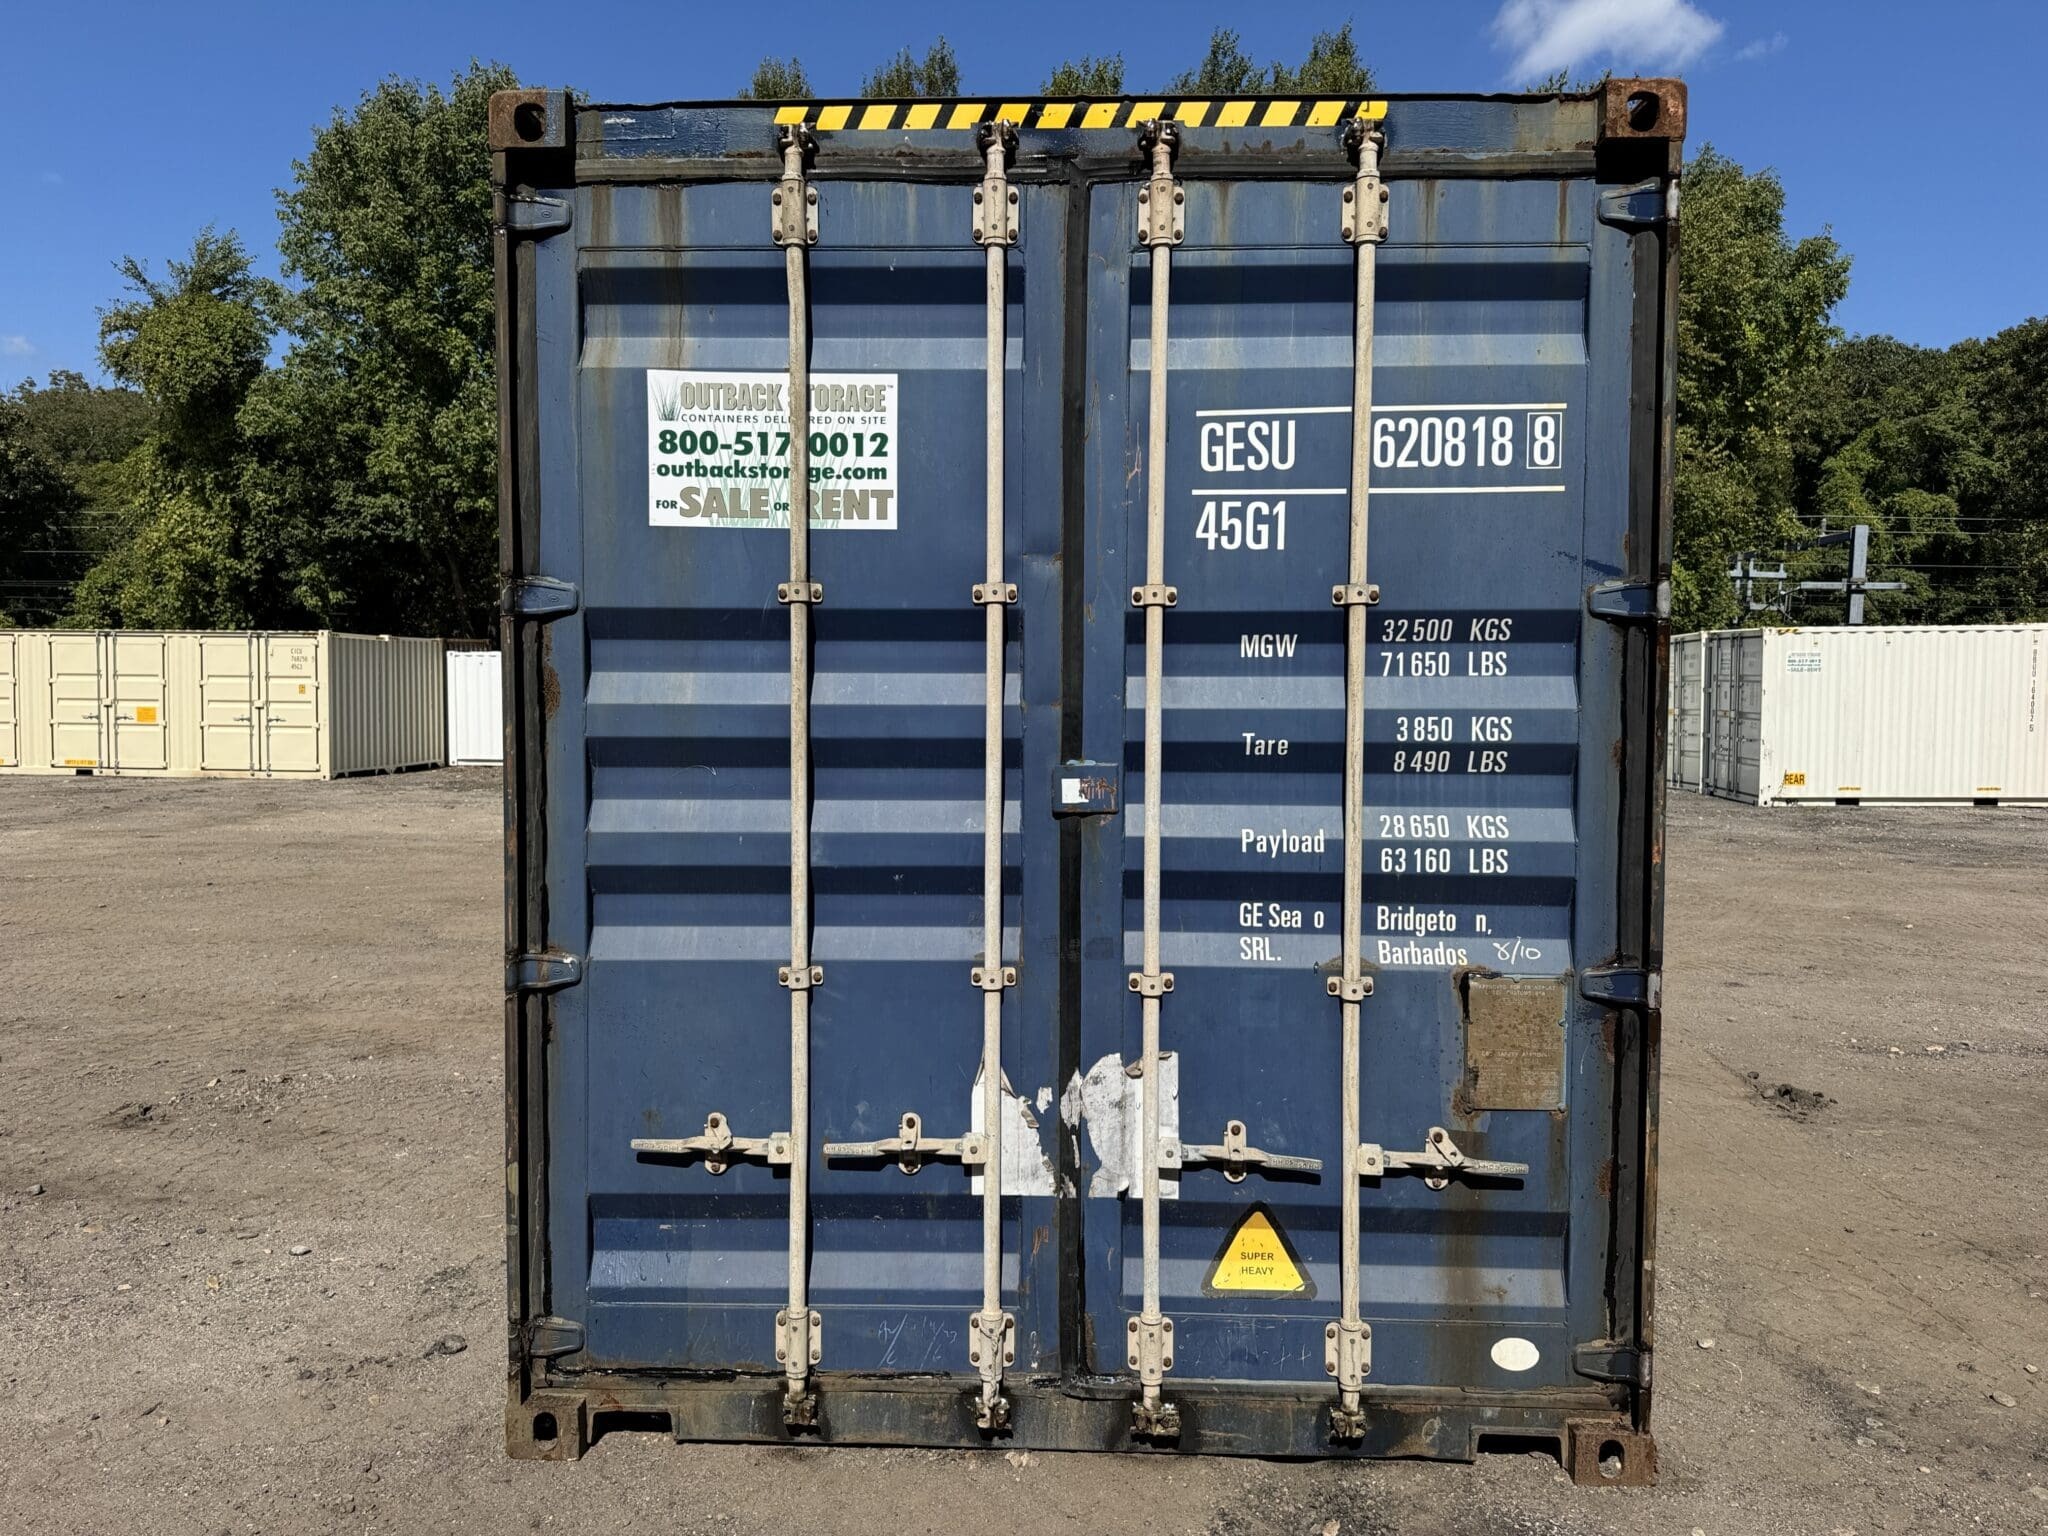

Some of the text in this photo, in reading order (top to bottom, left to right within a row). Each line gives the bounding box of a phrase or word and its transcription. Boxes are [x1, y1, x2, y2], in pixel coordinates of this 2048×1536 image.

[680, 382, 887, 412] OUTBACK ORAGE
[681, 413, 887, 425] CONTAINERS DELIRED ON SITE
[658, 429, 889, 458] 800-5170012
[1200, 416, 1556, 472] GESU 620818 8
[656, 460, 888, 484] outbackstorge.com
[656, 486, 894, 521] FOR SALE OR RENT
[1196, 500, 1287, 550] 45G1
[1469, 618, 1513, 641] KGS
[1240, 634, 1298, 658] MGW
[1468, 651, 1508, 676] LBS
[1470, 716, 1513, 742] KGS
[1242, 733, 1289, 756] Tare
[1467, 750, 1509, 773] LBS
[1784, 774, 1805, 784] REAR
[1467, 815, 1510, 839] KGS
[1241, 828, 1325, 859] Payload
[1469, 848, 1509, 875] LBS
[1239, 903, 1263, 928] GE
[1239, 937, 1282, 962] SRL.
[1377, 940, 1468, 966] Barbados
[1240, 1252, 1274, 1261] SUPER
[1241, 1266, 1274, 1275] HEAVY
